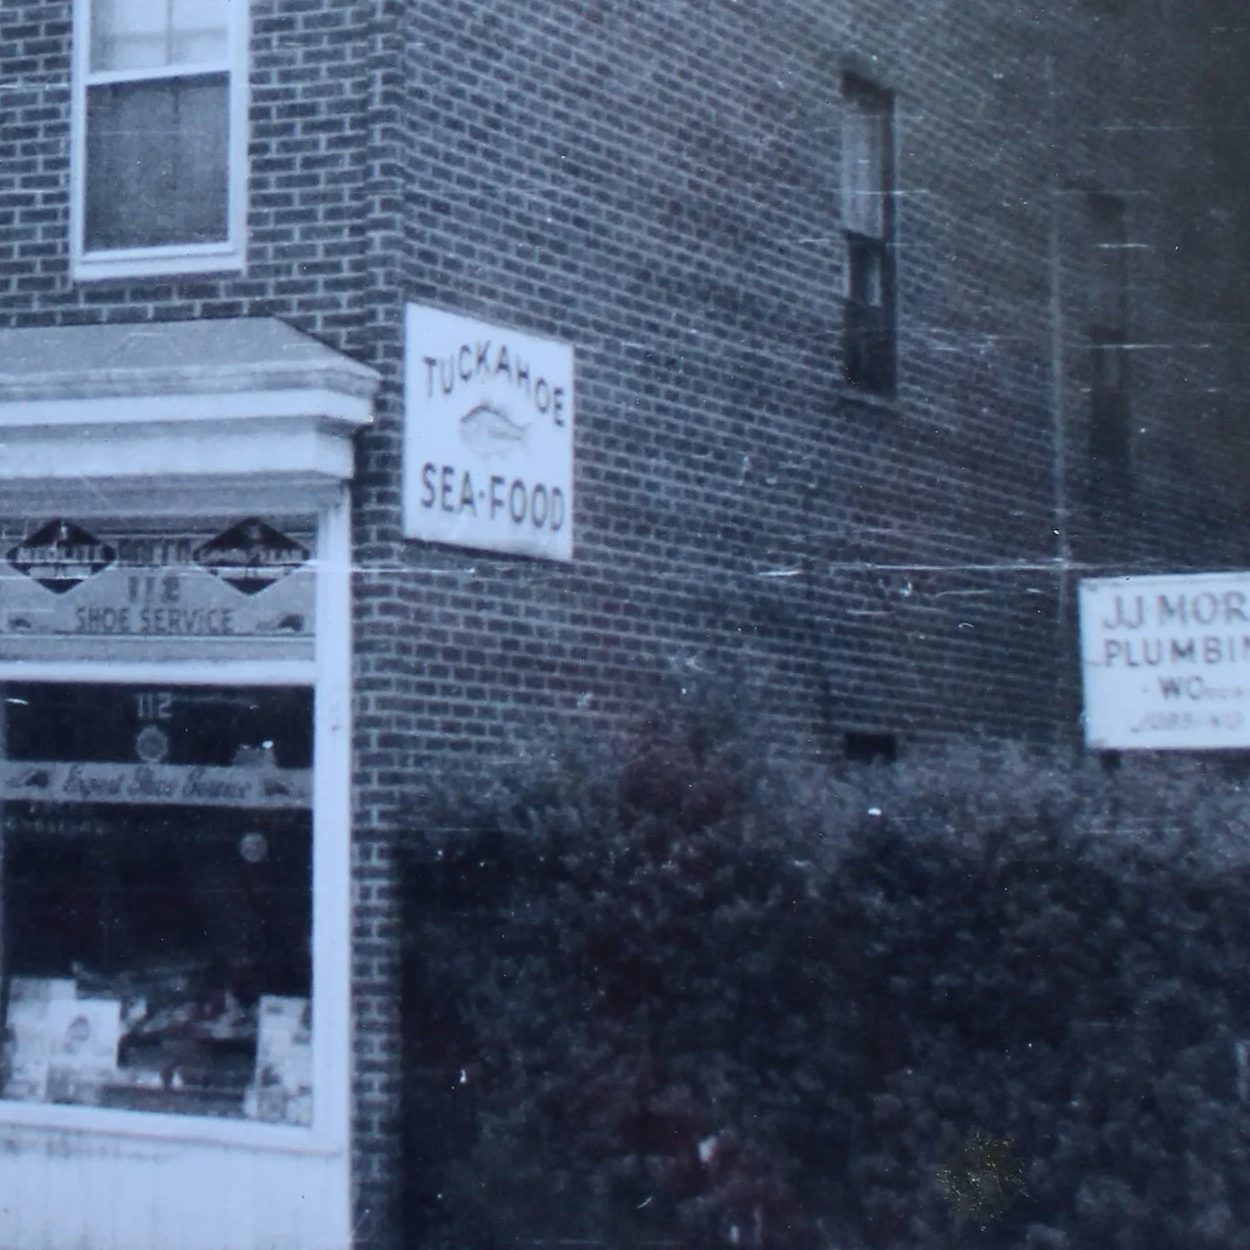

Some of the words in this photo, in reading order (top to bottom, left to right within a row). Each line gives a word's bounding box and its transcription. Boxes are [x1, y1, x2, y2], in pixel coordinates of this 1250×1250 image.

[422, 340, 566, 429] TUCKAHOE
[76, 607, 130, 633] SHOE
[140, 607, 235, 633] SERVICE
[134, 692, 173, 719] 112
